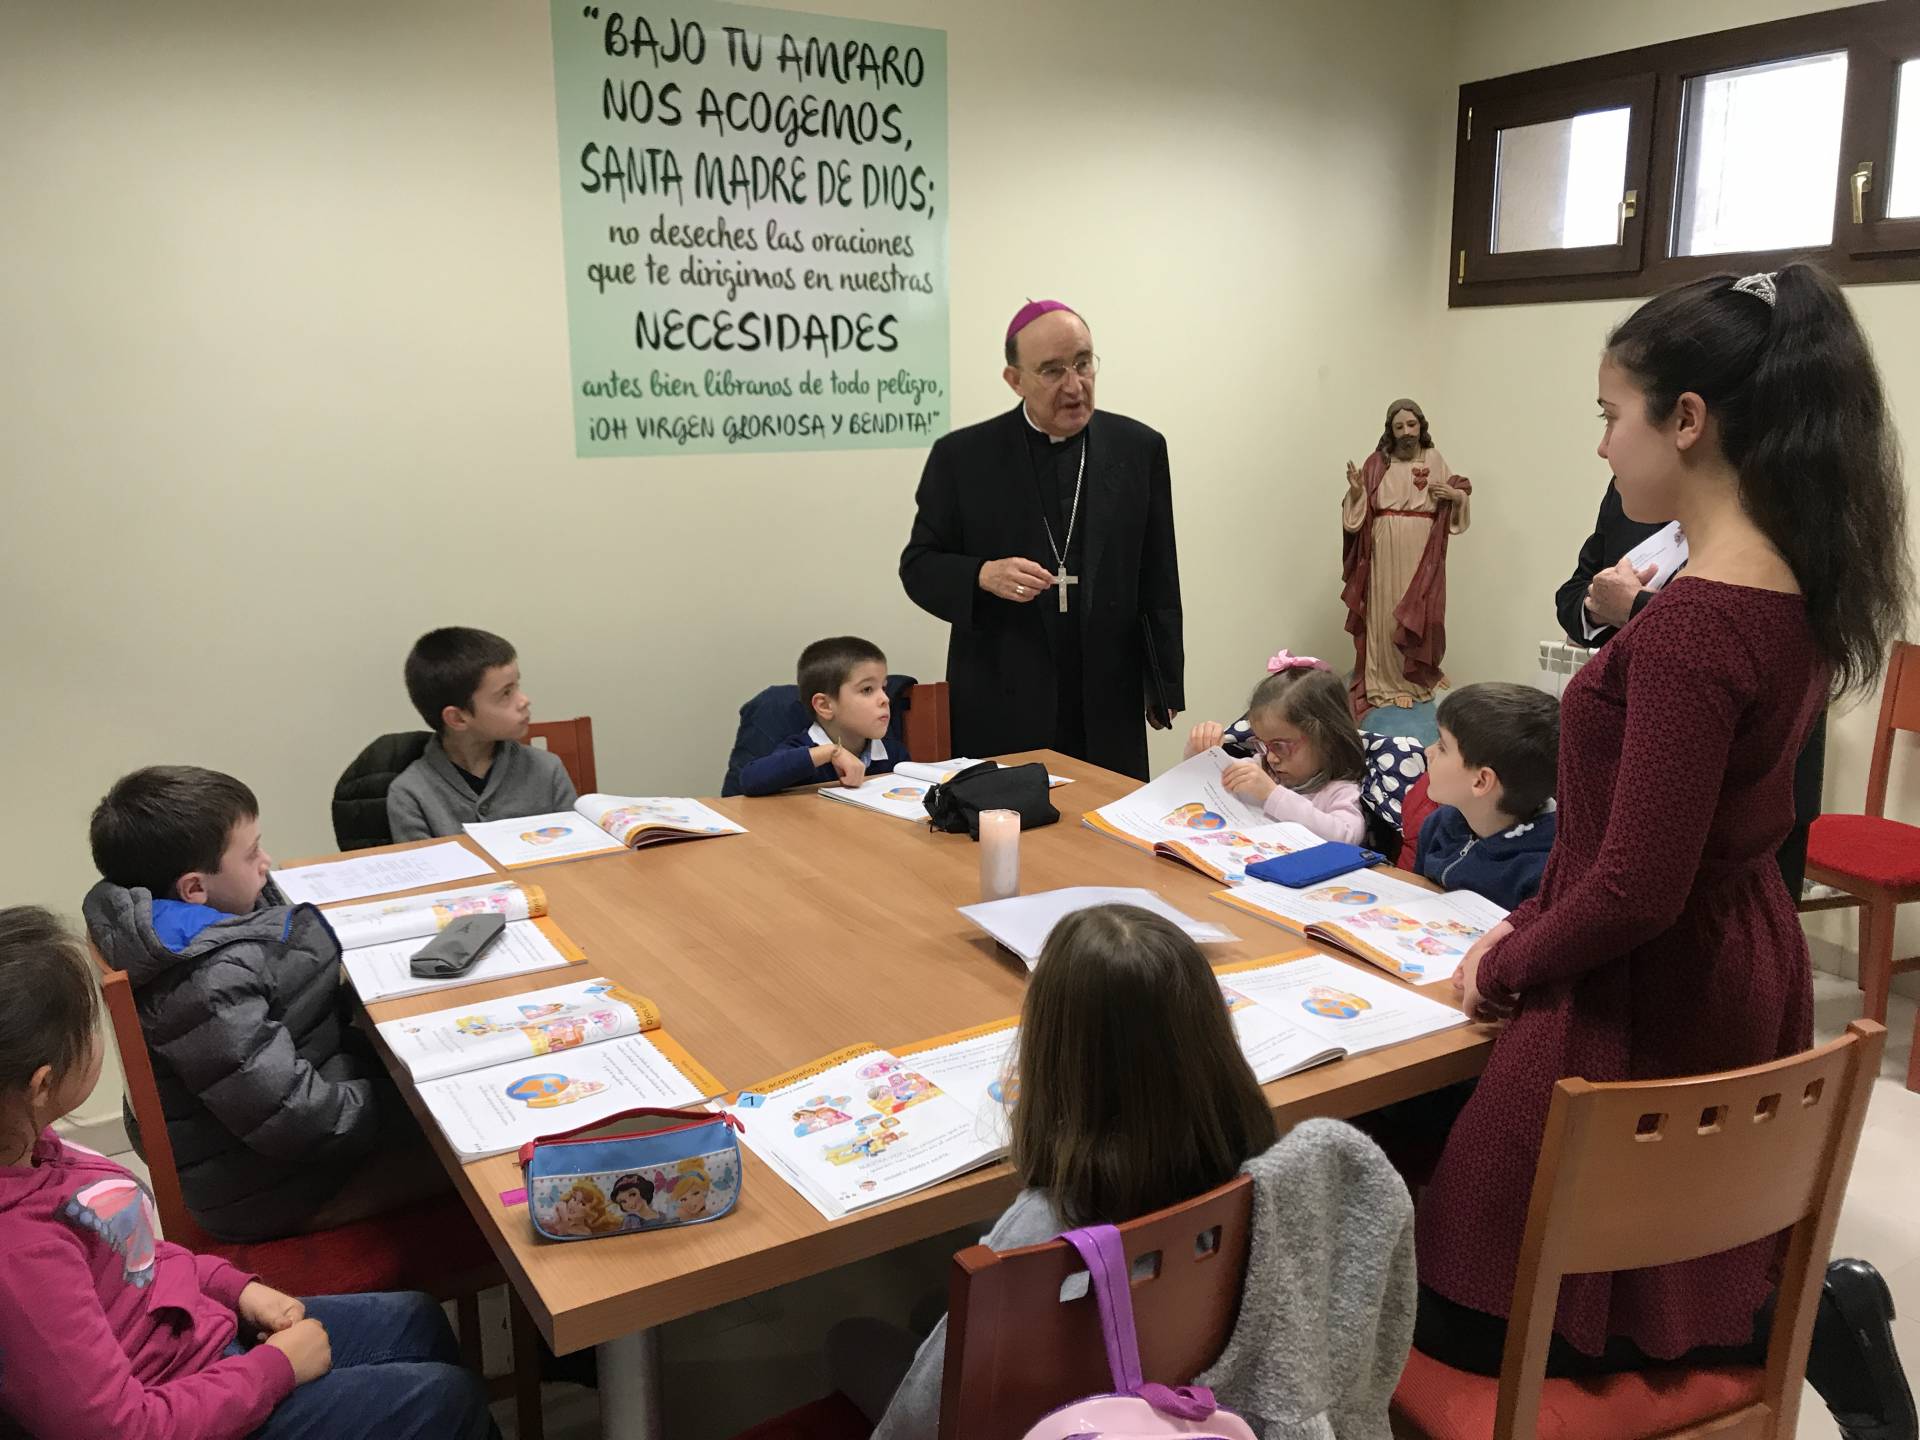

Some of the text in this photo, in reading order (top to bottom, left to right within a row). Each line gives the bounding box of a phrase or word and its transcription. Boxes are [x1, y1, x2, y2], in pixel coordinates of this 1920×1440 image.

[722, 27, 763, 72] TU
[776, 33, 925, 90] AMPARO
[602, 77, 913, 152] NOS ACOGEMOS,
[580, 141, 935, 220] SANTA MADRE DE DIOS;
[609, 213, 915, 257] no deseches las oraciones
[587, 254, 934, 301] que te dirigimos en nuestras
[635, 309, 899, 358] NECESIDADES
[582, 369, 643, 398] antes
[650, 369, 699, 398] bien
[799, 369, 823, 395] de
[830, 369, 870, 395] todo
[877, 369, 943, 406] peligro,
[636, 414, 714, 446] VIRGEN
[723, 414, 825, 444] GLORIOSA
[831, 414, 843, 435] Y
[743, 1095, 754, 1107] 7
